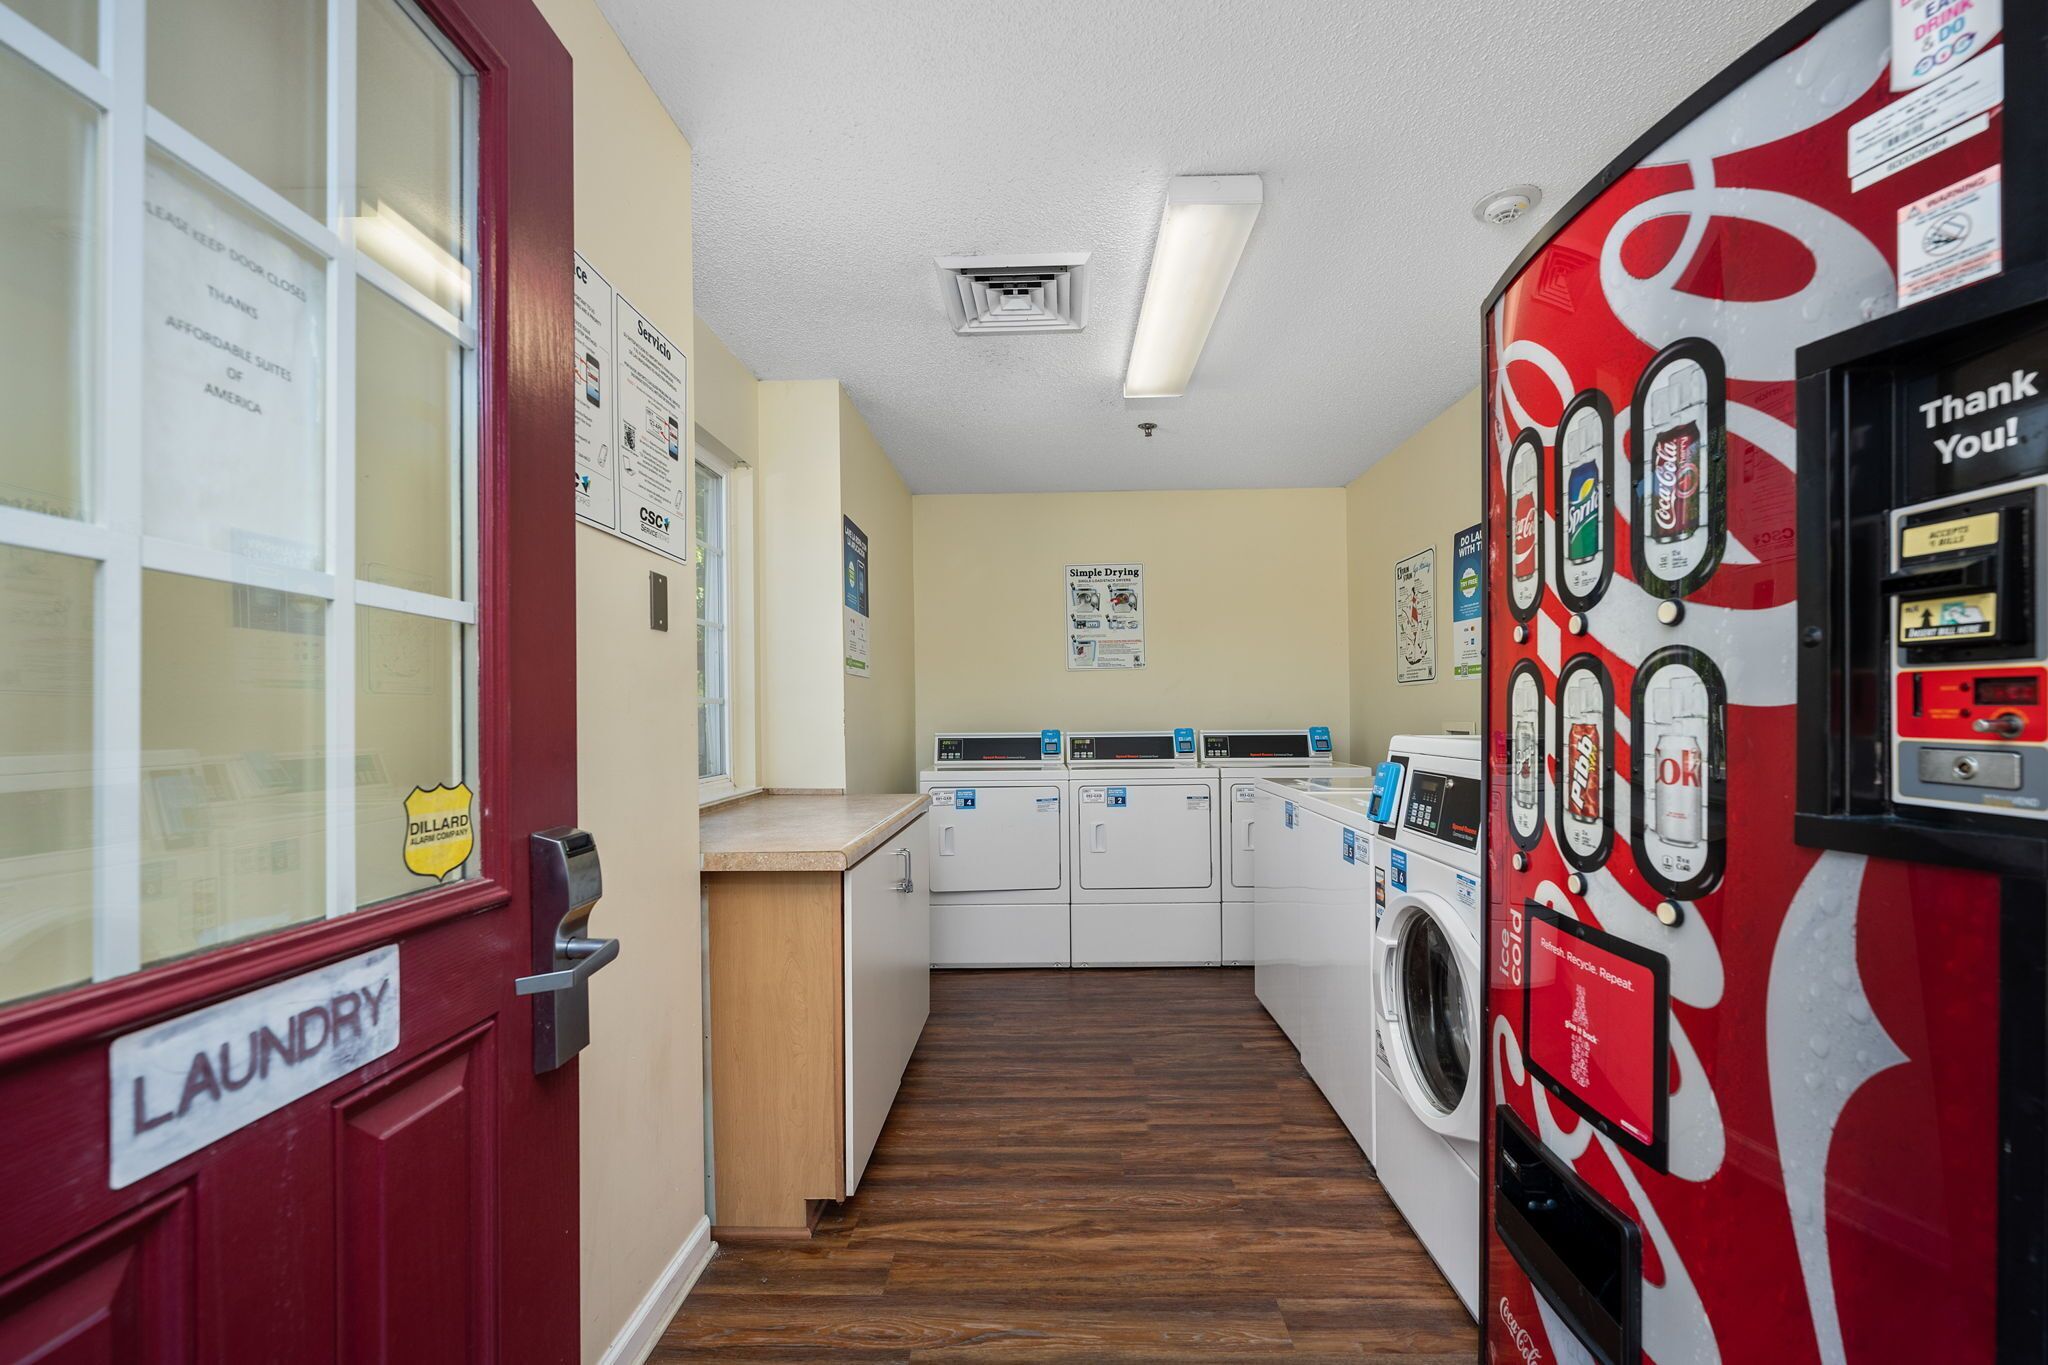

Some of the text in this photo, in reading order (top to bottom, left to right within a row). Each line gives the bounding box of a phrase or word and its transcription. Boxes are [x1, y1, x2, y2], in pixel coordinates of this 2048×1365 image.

[1914, 0, 1974, 41] DRINK
[1939, 16, 1966, 42] DO
[192, 227, 227, 253] KEEP
[229, 248, 266, 279] DOOR
[207, 284, 259, 321] THANKS
[165, 315, 293, 383] AFFORDABLE SUITES
[637, 319, 672, 362] Servicio
[226, 366, 244, 382] OF
[204, 382, 263, 415] AMERICA
[1919, 369, 2040, 429] Thank
[1933, 416, 2019, 465] You!
[640, 506, 664, 529] CSC
[1458, 543, 1476, 558] WITH
[1460, 535, 1470, 547] DO
[1069, 568, 1140, 578] Simple Drying
[409, 814, 469, 837] DILLARD
[409, 828, 469, 847] ALARM COMPANY
[1399, 872, 1404, 884] 6
[1499, 928, 1510, 978] ice
[1510, 907, 1522, 986] cold
[1540, 936, 1637, 993] Refresh. Recycle. Repeat.
[133, 977, 390, 1136] LAUNDRY
